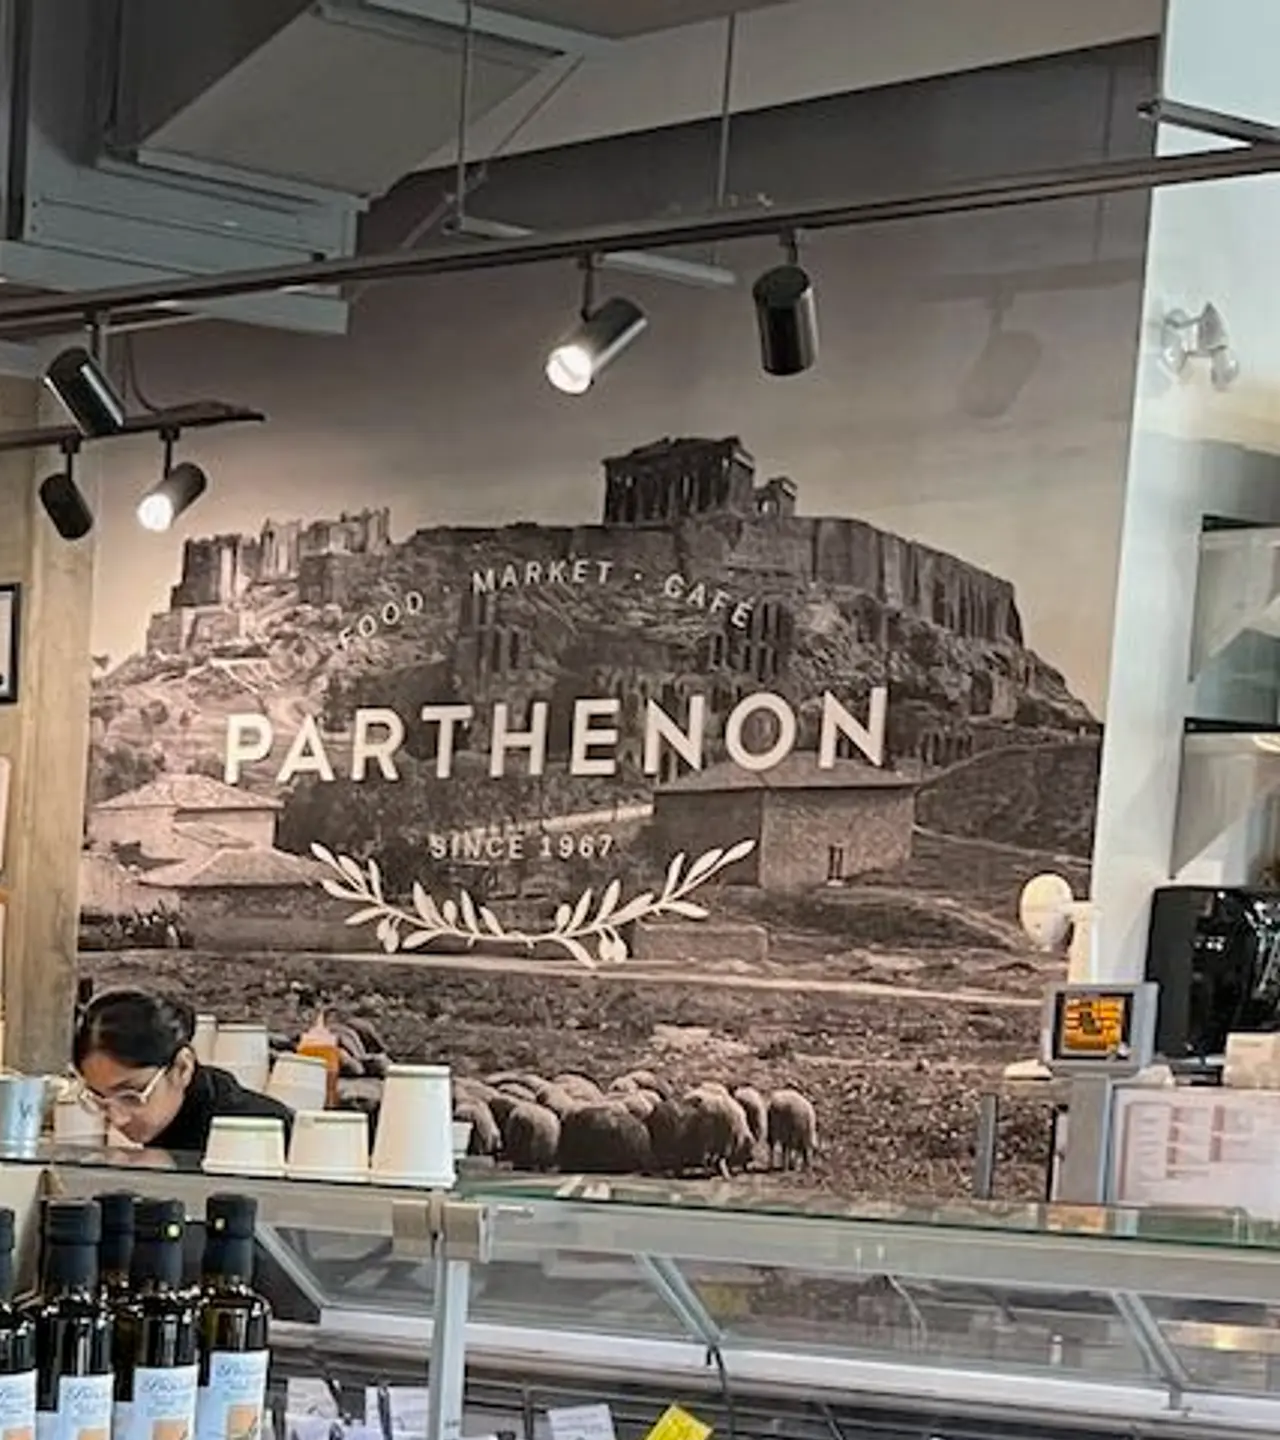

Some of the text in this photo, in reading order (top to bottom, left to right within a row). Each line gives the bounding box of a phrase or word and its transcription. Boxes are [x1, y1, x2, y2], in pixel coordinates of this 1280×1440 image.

[337, 558, 754, 653] FOOD MARKET CAFÉ
[224, 685, 891, 787] PARTHENON
[428, 832, 615, 861] SINCE 1967
